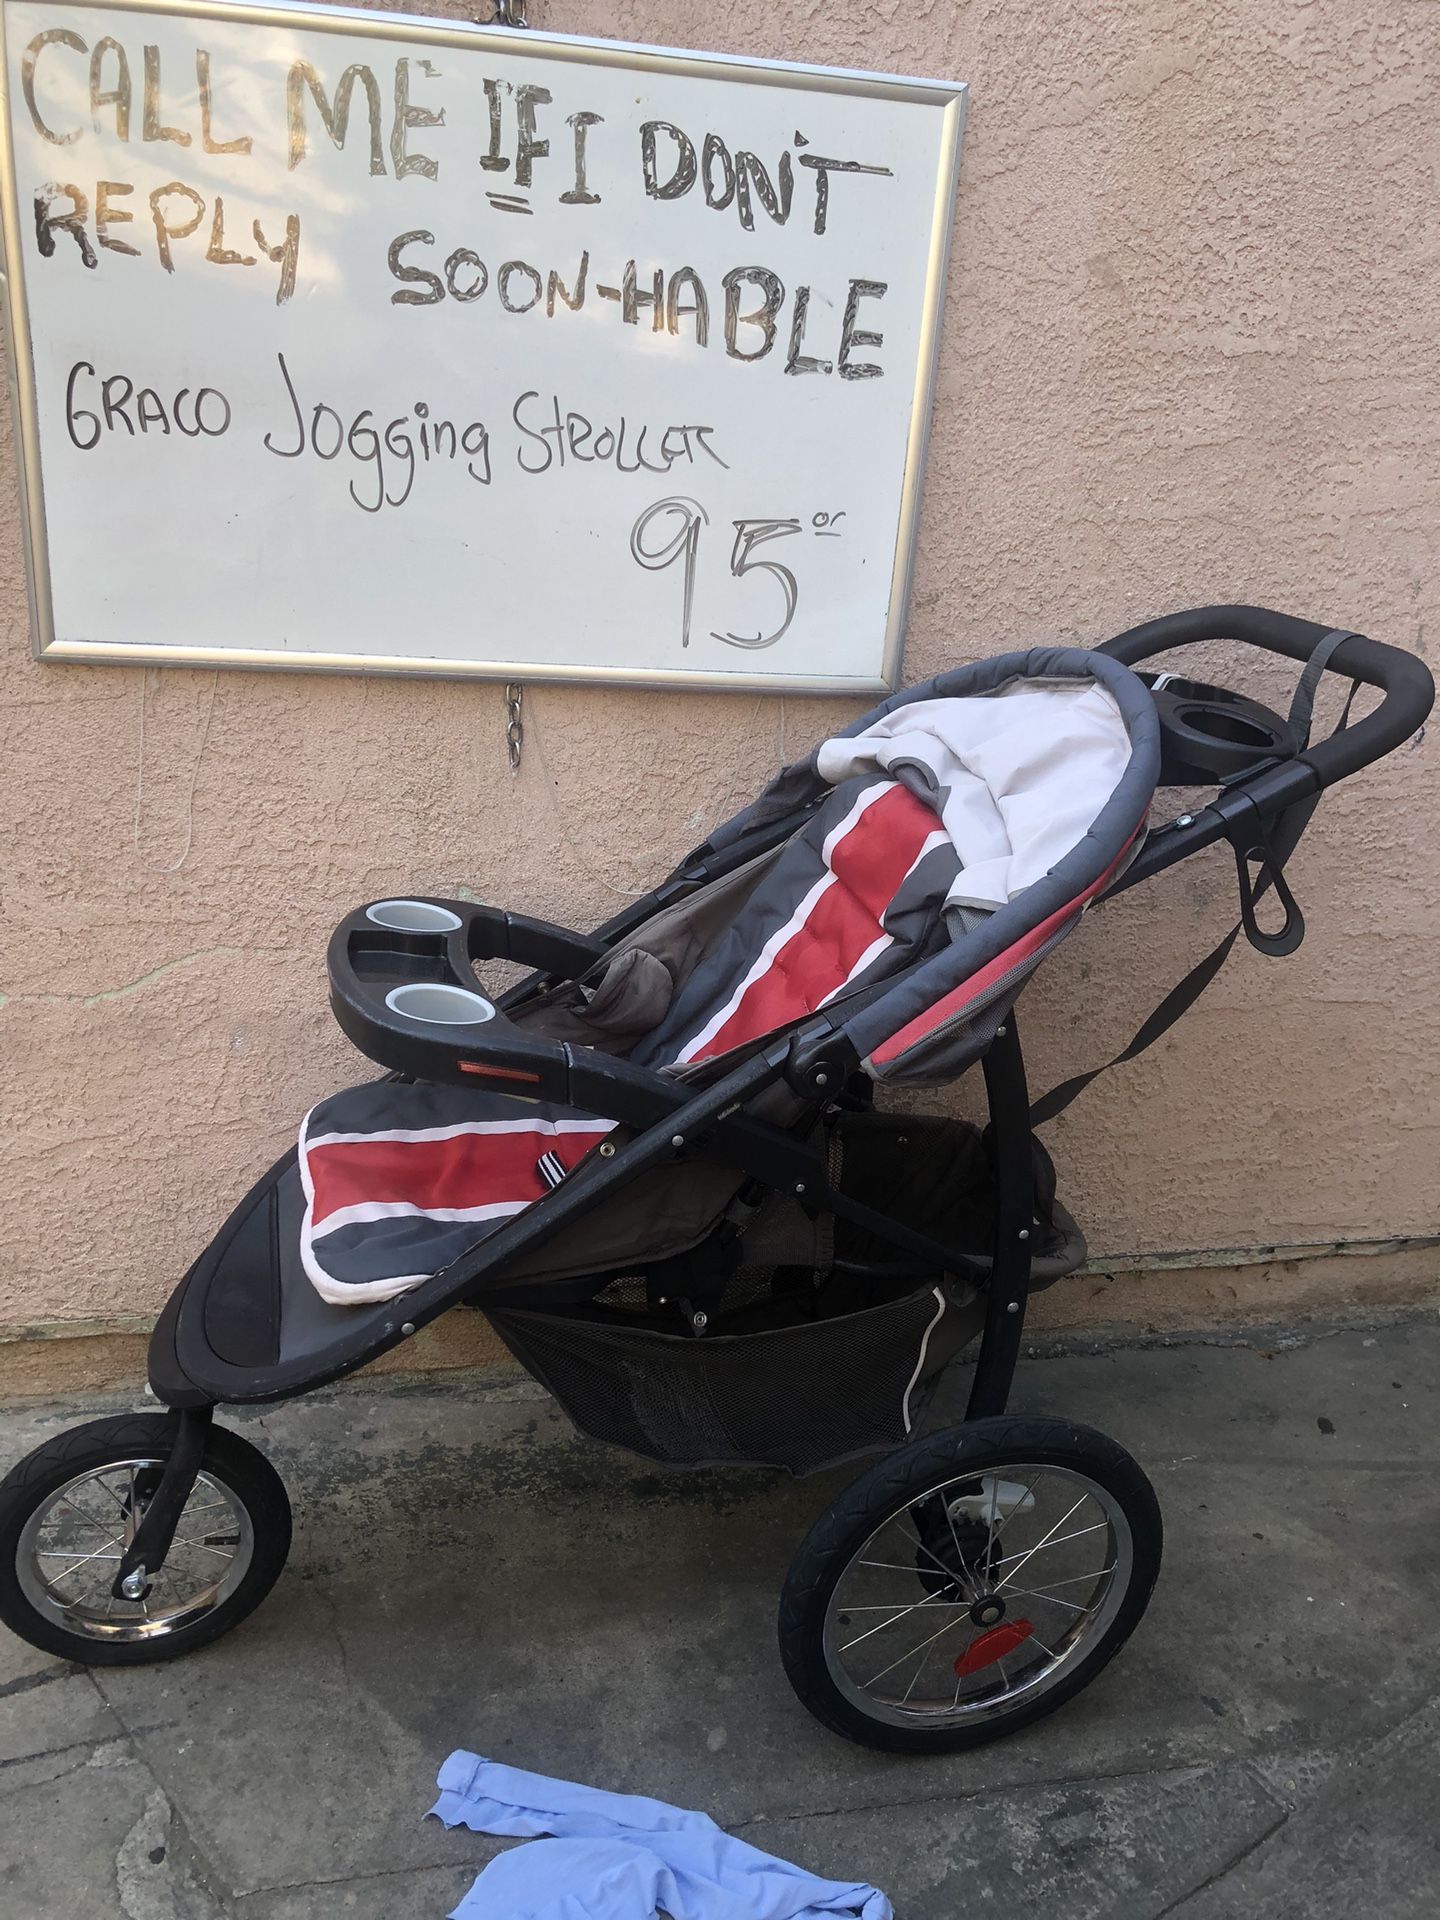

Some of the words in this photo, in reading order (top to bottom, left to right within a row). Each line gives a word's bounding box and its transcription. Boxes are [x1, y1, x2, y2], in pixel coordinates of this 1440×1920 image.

[21, 28, 254, 155] CALL
[286, 57, 446, 181] ME
[480, 77, 553, 189] IF
[559, 111, 605, 205] I
[638, 120, 894, 236] DON'T
[33, 181, 300, 306] REPLY
[66, 360, 231, 450] GRACO
[264, 352, 491, 513] Jogging
[630, 495, 803, 650] 95
